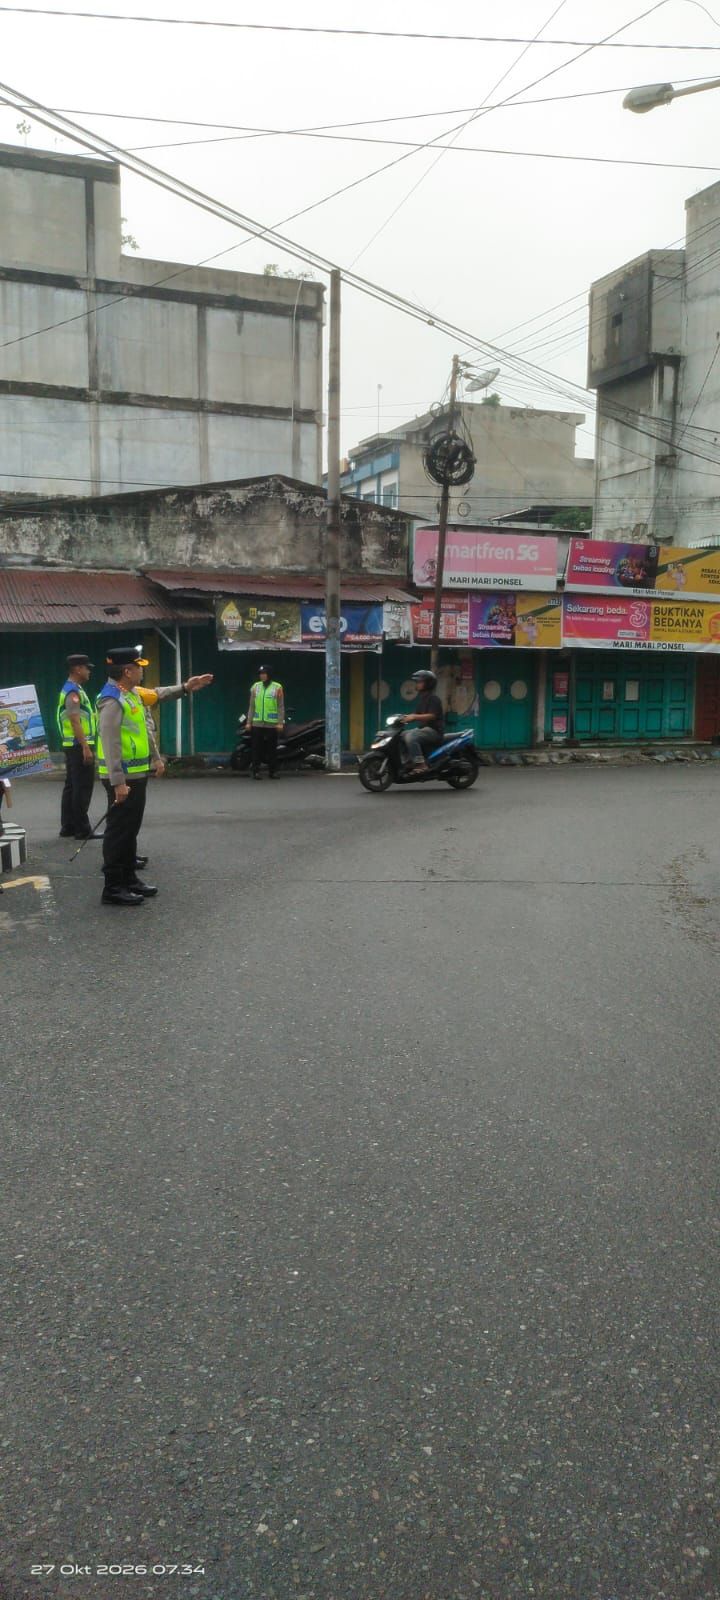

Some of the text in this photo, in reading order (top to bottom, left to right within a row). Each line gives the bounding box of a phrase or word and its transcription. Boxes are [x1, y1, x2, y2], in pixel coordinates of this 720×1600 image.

[517, 544, 539, 561] 5G
[579, 556, 611, 566] Streaming
[592, 567, 615, 575] loading
[449, 576, 524, 586] MARI MARI PONSEL
[566, 603, 604, 616] Sekarang
[606, 605, 628, 615] beda.
[629, 601, 648, 628] 3
[653, 606, 705, 619] BUKTIKAN
[653, 617, 703, 629] BEDANYA
[612, 641, 685, 651] MARI MARI PONSEL
